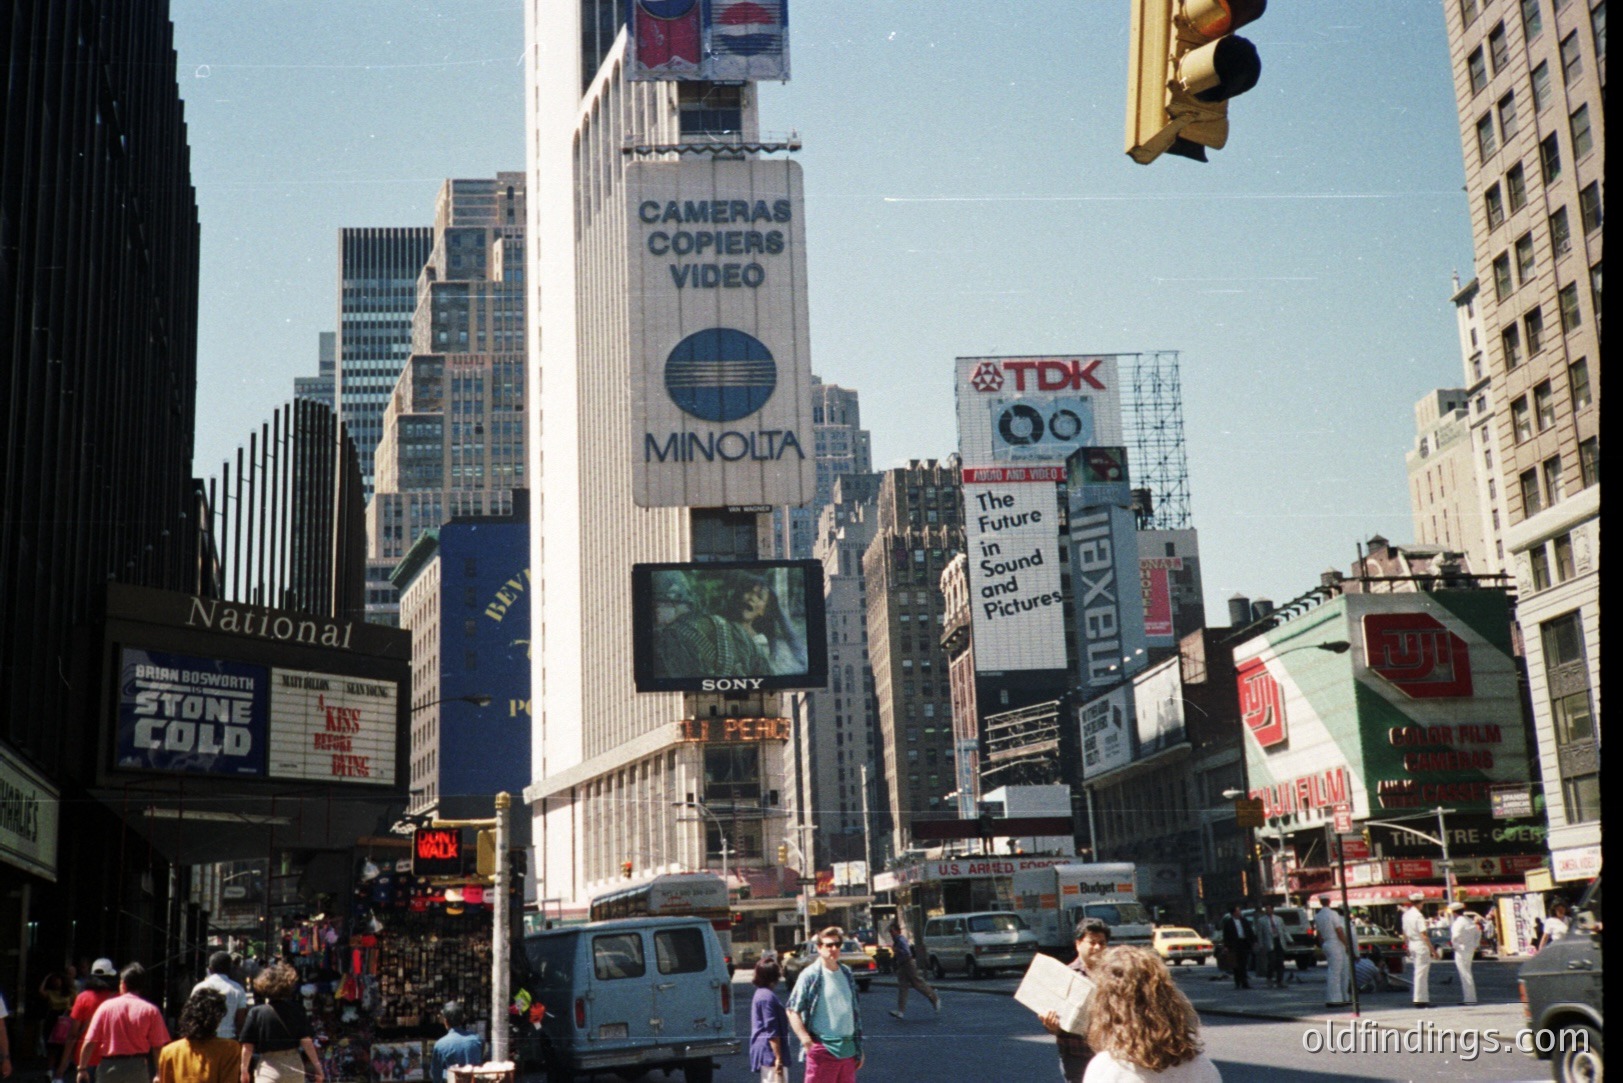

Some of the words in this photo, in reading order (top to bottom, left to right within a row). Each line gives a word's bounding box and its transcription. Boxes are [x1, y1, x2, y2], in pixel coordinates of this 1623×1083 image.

[638, 199, 792, 224] CAMERAS
[647, 230, 785, 255] COPIERS
[669, 262, 766, 289] VIDEO
[1003, 360, 1107, 391] TDK
[644, 430, 806, 463] MINOLTA
[973, 468, 1001, 482] AUDIO
[1006, 468, 1026, 481] AND
[1030, 467, 1057, 480] VIDEO
[976, 490, 1014, 512] The
[978, 509, 1042, 533] Future
[980, 541, 1000, 557] in
[980, 548, 1043, 577] Sound
[981, 575, 1018, 598] and
[983, 590, 1062, 620] Pictures
[185, 597, 353, 649] National
[135, 663, 179, 684] BRIAN
[182, 669, 254, 691] BOSWORTH
[702, 678, 764, 691] SONY
[134, 690, 253, 724] STONE
[316, 693, 325, 711] A
[325, 705, 361, 733] KISS
[134, 718, 252, 756] COLD
[314, 732, 353, 753] BEFORE
[1389, 726, 1454, 747] COLOR
[1459, 724, 1502, 744] FILM
[332, 753, 370, 777] DYING
[1404, 750, 1494, 772] CAMERAS
[1296, 767, 1347, 810] FILM
[417, 830, 457, 844] DONT
[417, 842, 458, 859] WALK
[938, 864, 961, 876] U.S.
[1080, 882, 1115, 895] Budget
